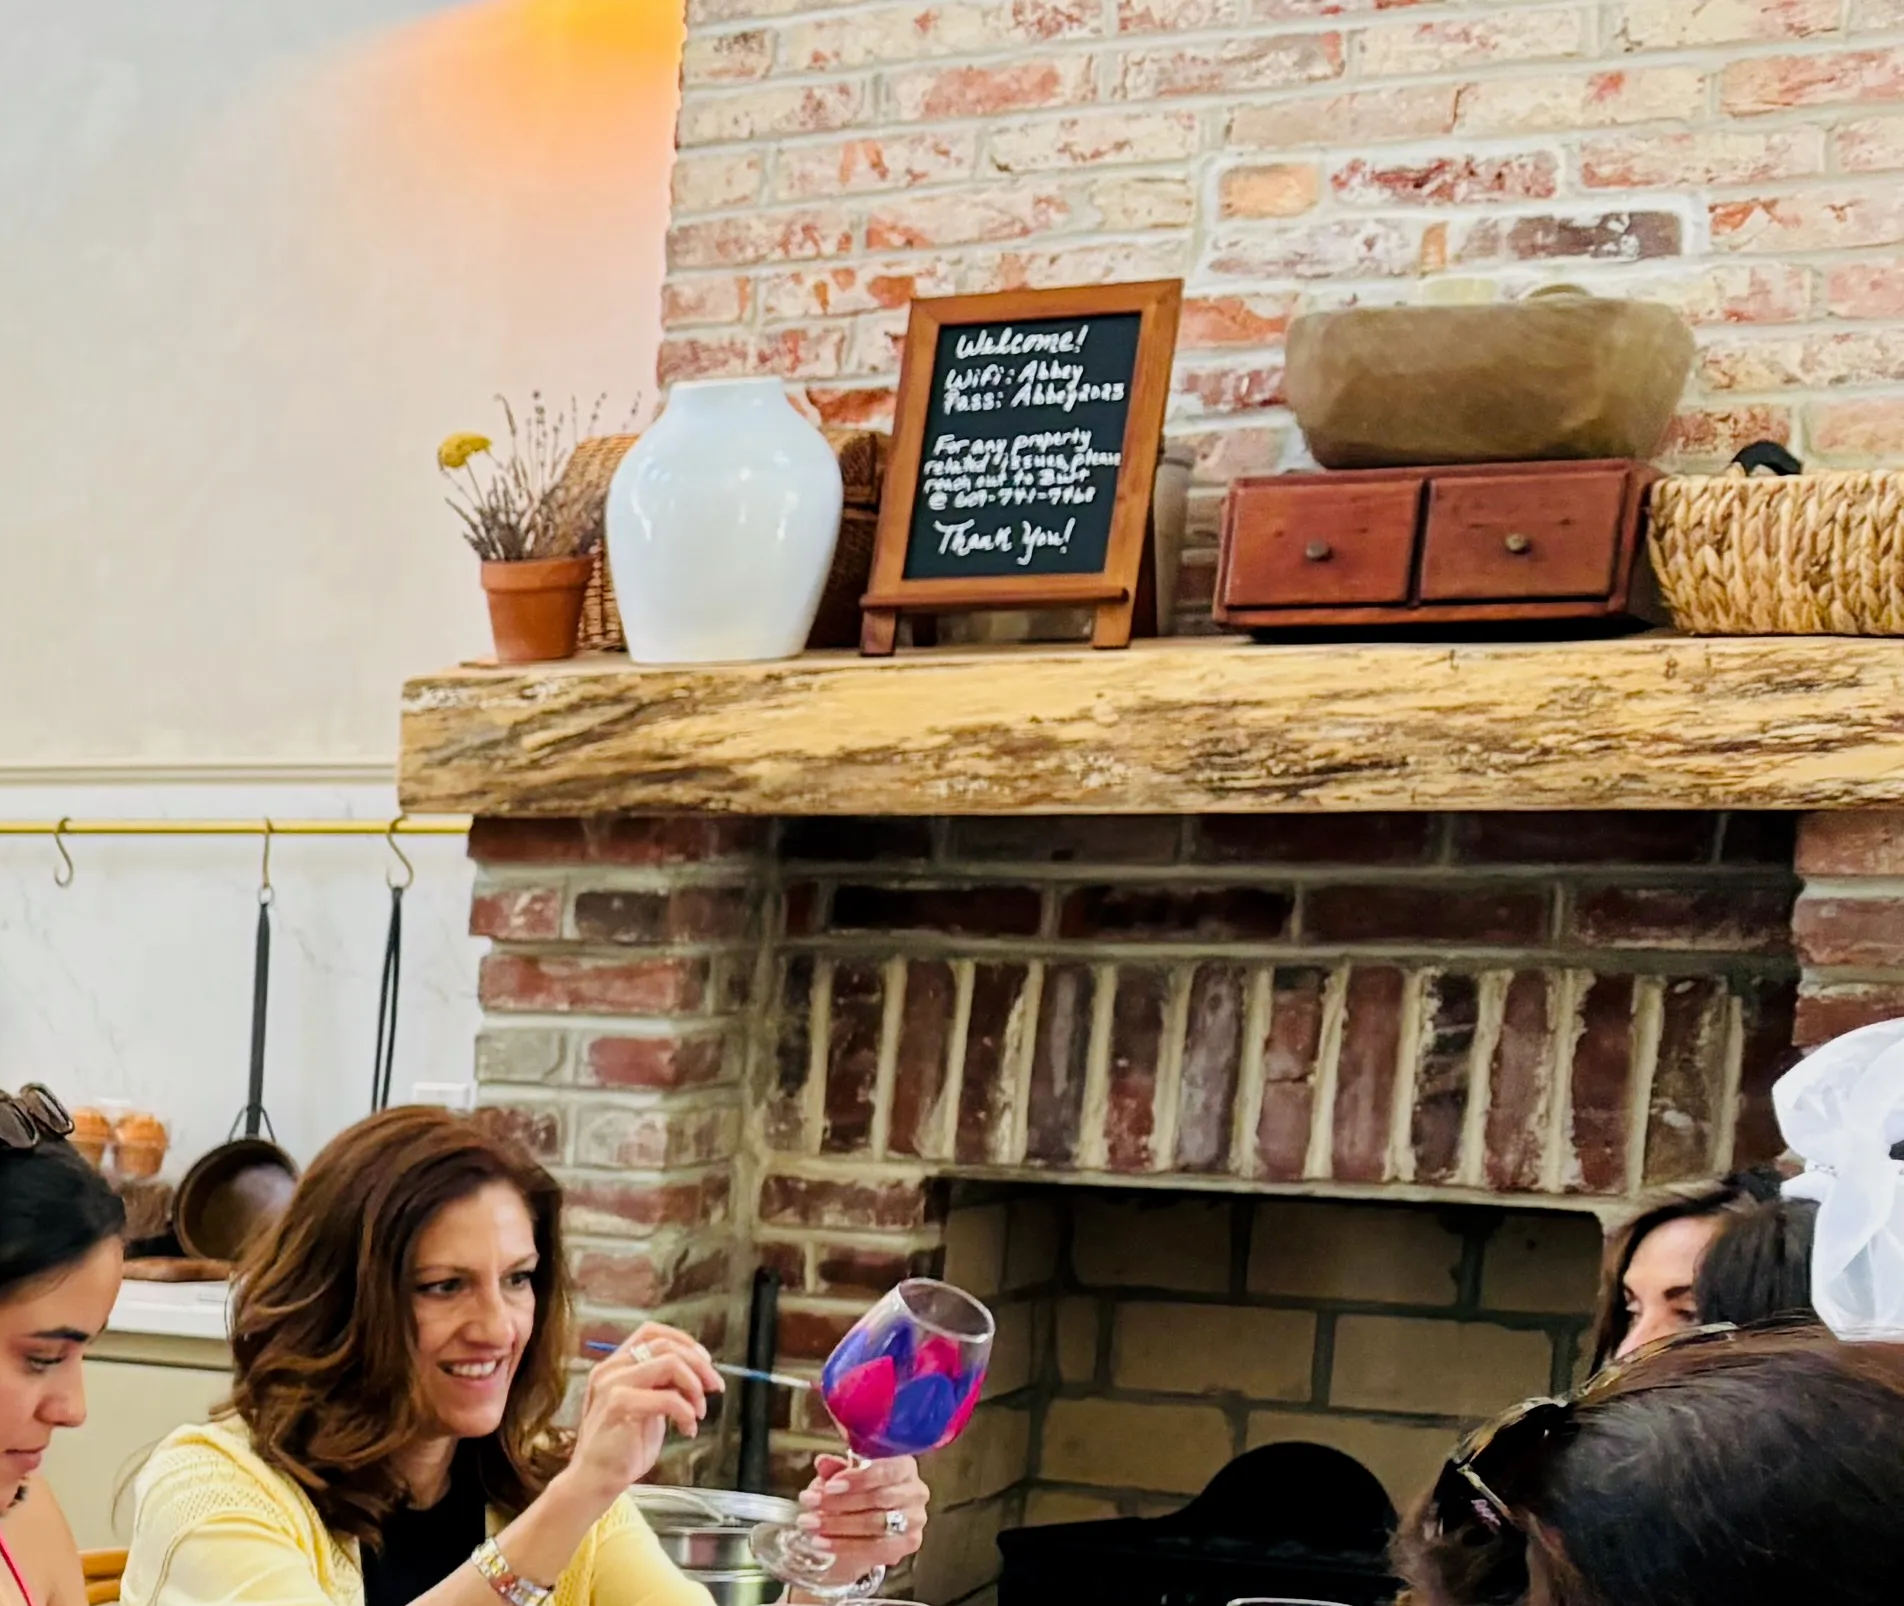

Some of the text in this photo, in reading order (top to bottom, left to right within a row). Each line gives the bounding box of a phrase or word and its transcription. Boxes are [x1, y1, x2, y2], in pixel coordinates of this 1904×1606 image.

[955, 324, 1089, 359] Welcome!
[1017, 360, 1083, 391] Abbey
[944, 387, 1005, 415] Pass:
[933, 427, 1092, 465] For any property
[923, 452, 990, 475] related
[1068, 448, 1122, 477] please
[923, 474, 972, 495] reach
[975, 470, 1007, 488] out
[1013, 468, 1034, 490] to
[928, 490, 949, 511] @
[933, 517, 1076, 566] Thank You!
